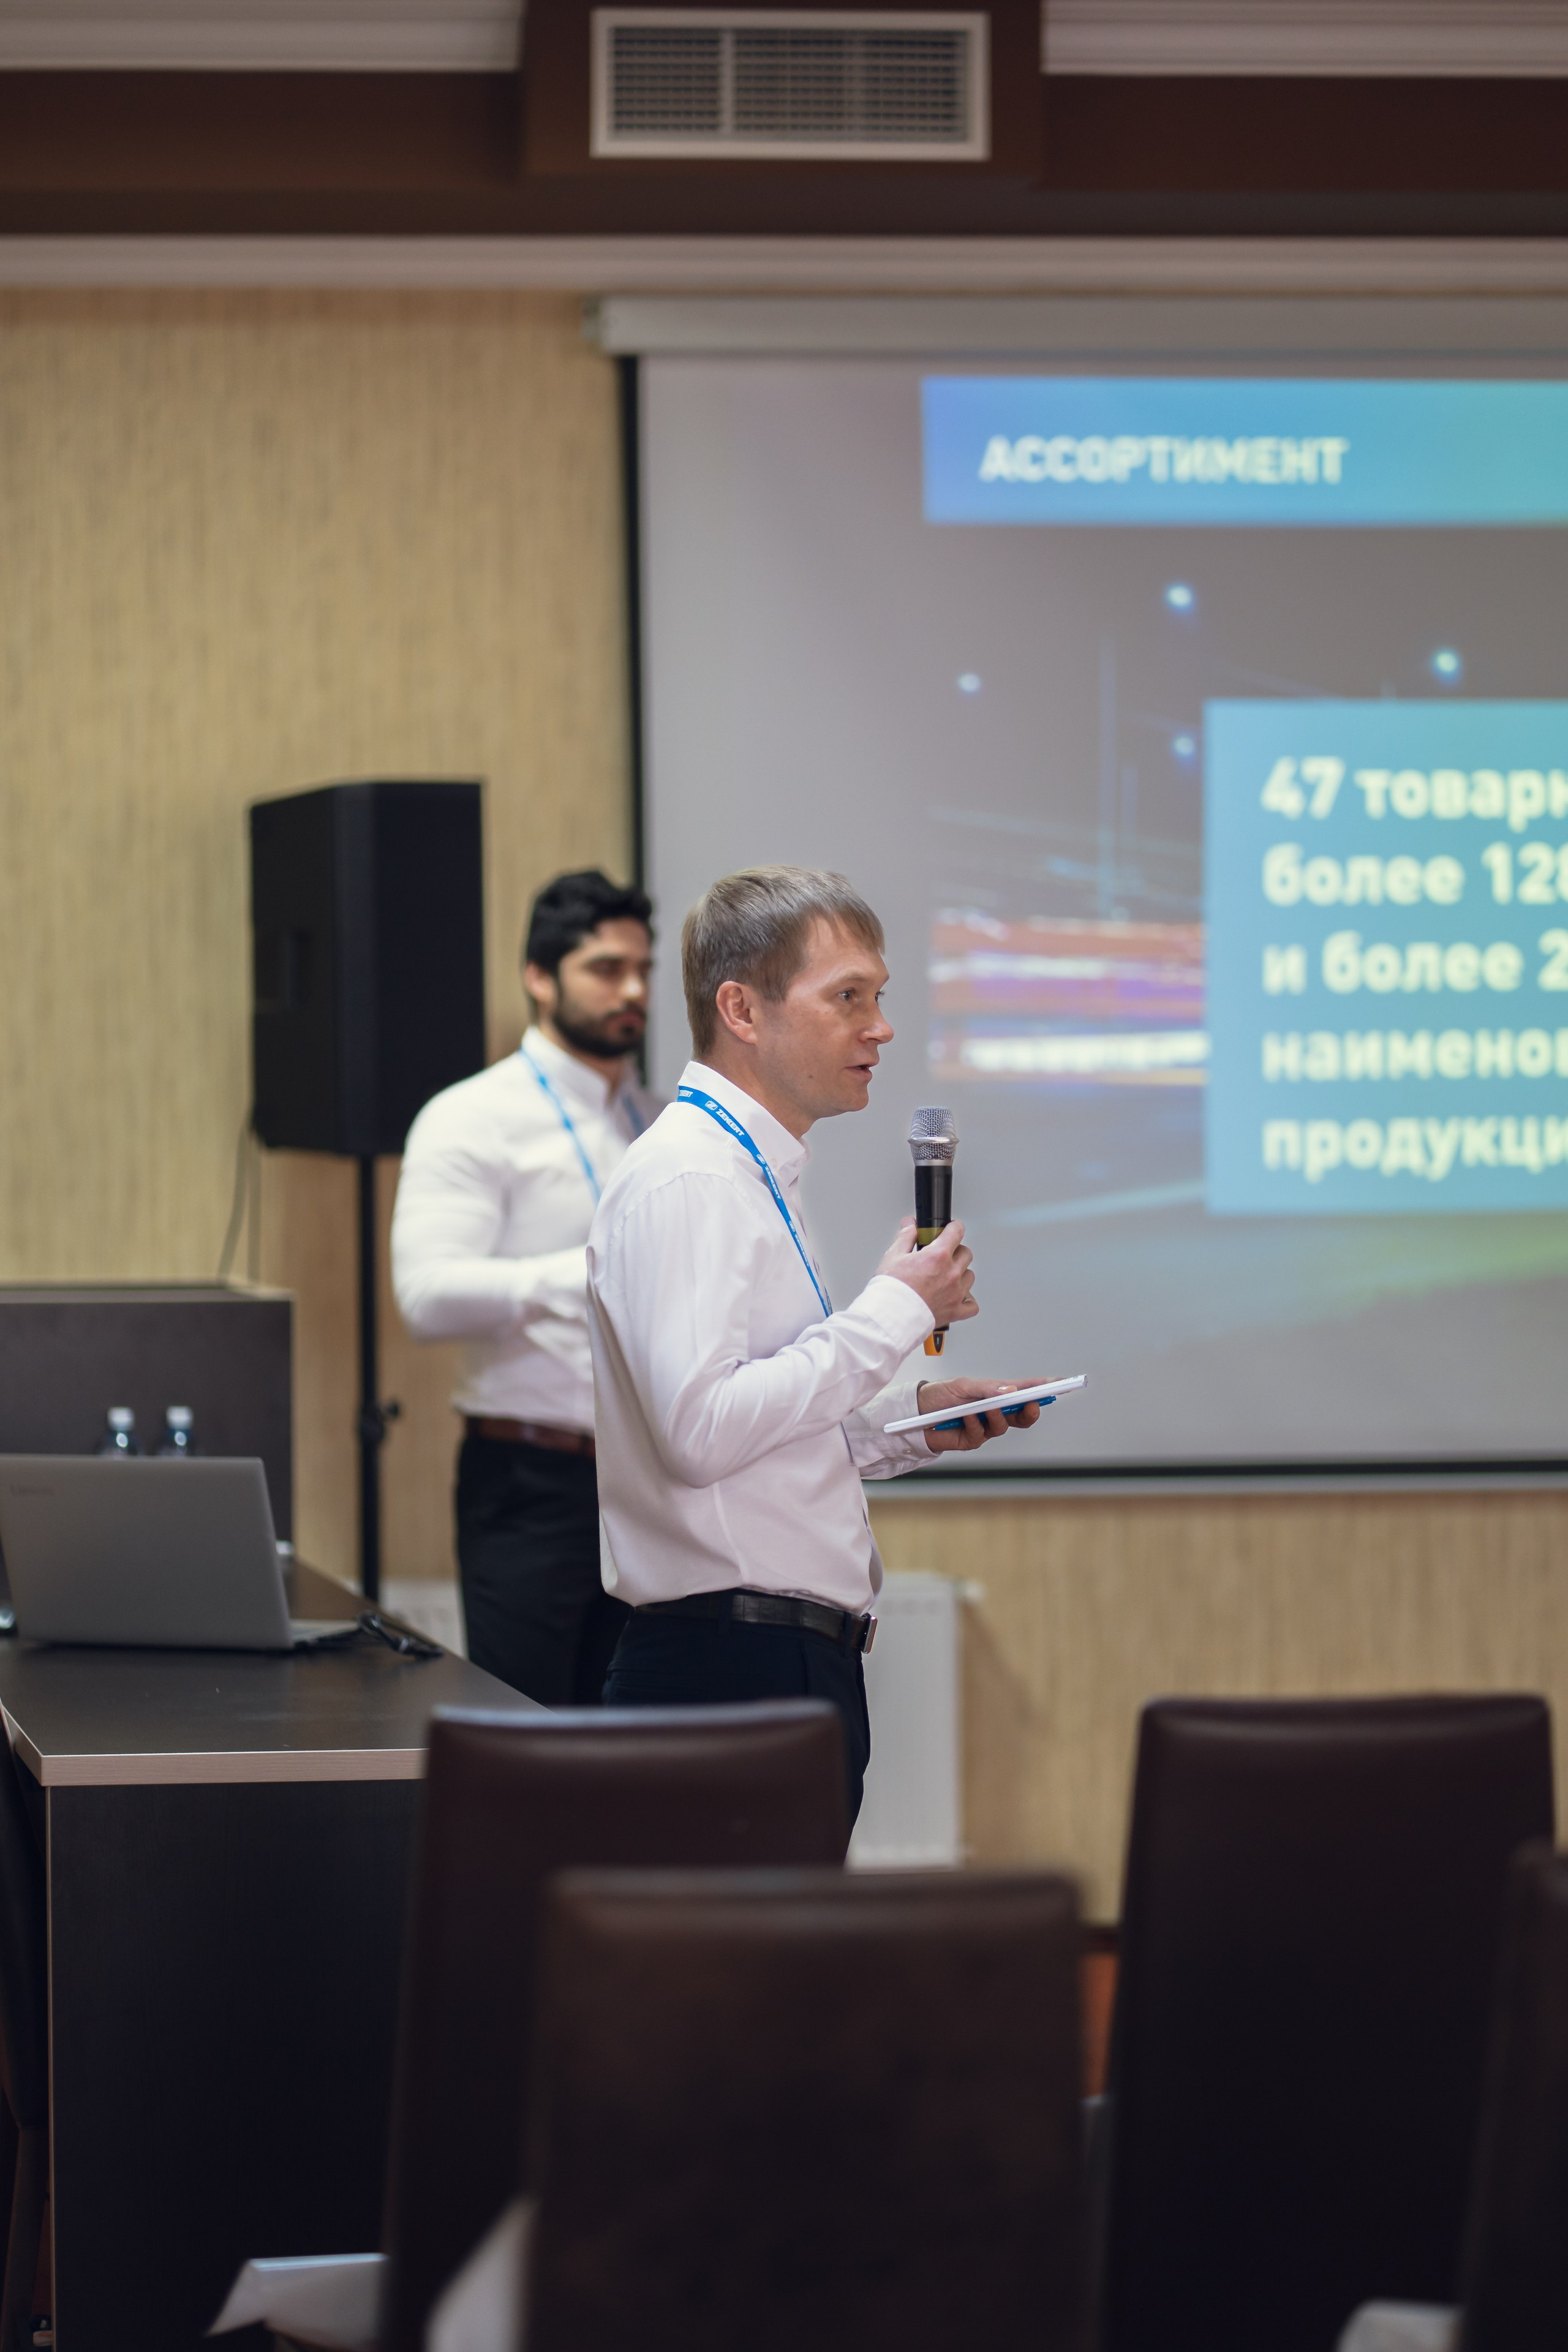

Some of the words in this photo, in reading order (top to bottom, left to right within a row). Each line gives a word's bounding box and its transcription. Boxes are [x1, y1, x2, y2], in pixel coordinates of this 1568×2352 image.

[979, 435, 1349, 483] АССОРТИМЕНТ
[1261, 756, 1345, 819] 47
[1262, 842, 1464, 907] более
[1263, 944, 1306, 995] и
[1322, 930, 1523, 993] более
[1538, 929, 1568, 991] 2
[715, 1109, 745, 1136] ZEKERT
[765, 1165, 781, 1199] ZEKERT
